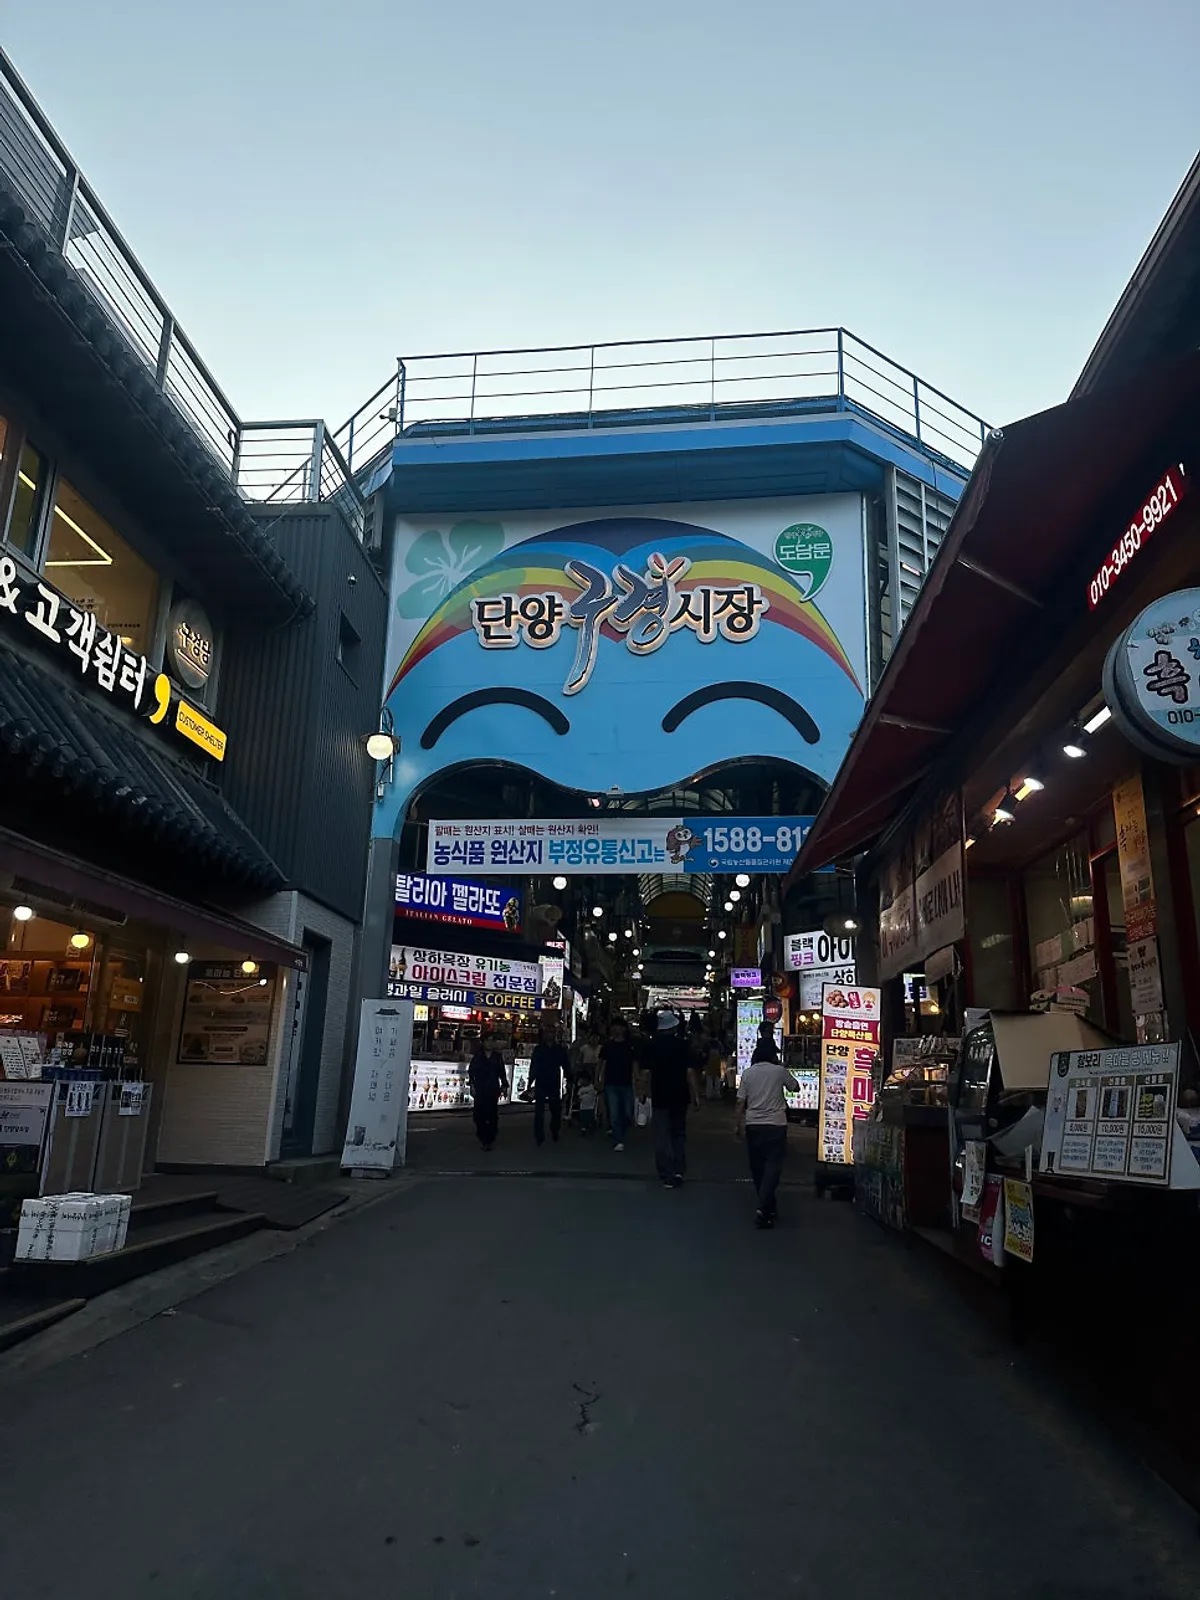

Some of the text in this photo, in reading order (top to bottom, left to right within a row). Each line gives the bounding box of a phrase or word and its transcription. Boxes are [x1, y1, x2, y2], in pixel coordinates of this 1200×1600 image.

[1089, 474, 1178, 605] 010-3450-9921
[779, 543, 830, 560] 도담문
[24, 583, 147, 710] 고객쉼터
[179, 711, 224, 750] CUSTOMER SHELTER
[435, 824, 599, 836] 팔때는 원산지 표시! 살때는 원산지 확인!
[434, 840, 484, 866] 농식품
[491, 840, 542, 865] 원산지
[404, 909, 472, 925] ITALIAN GELATO
[790, 937, 814, 952] 블랙
[475, 957, 511, 973] 유기농
[791, 952, 814, 967] 핑크
[412, 964, 537, 993] 아이스크림 전문점
[485, 993, 536, 1009] COFFEE
[826, 1044, 850, 1057] 단양
